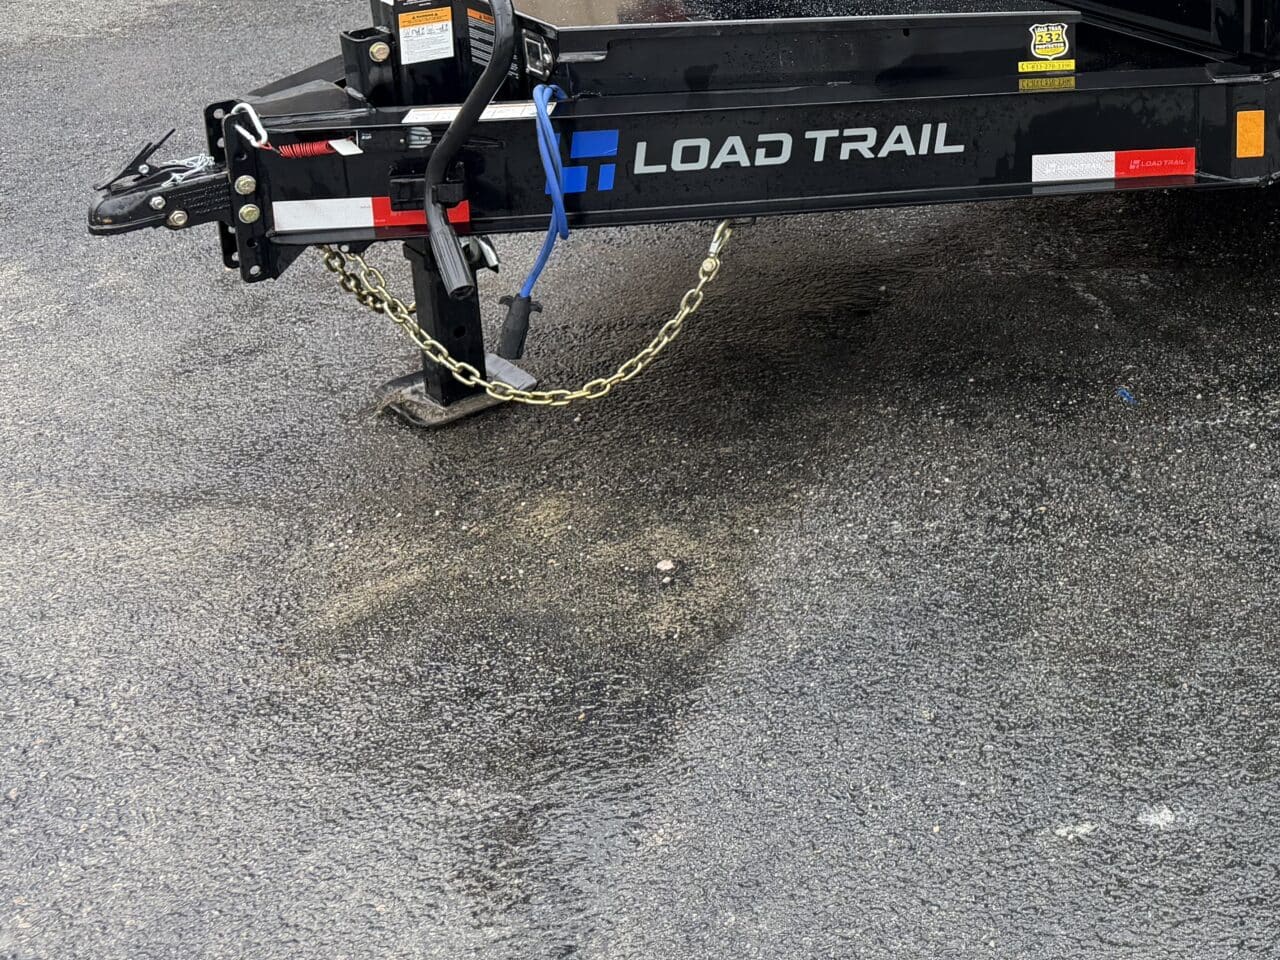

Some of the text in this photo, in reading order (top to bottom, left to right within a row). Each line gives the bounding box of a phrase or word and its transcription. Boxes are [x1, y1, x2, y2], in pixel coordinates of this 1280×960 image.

[1037, 32, 1061, 43] 232
[633, 122, 965, 175] LOAD TRAIL
